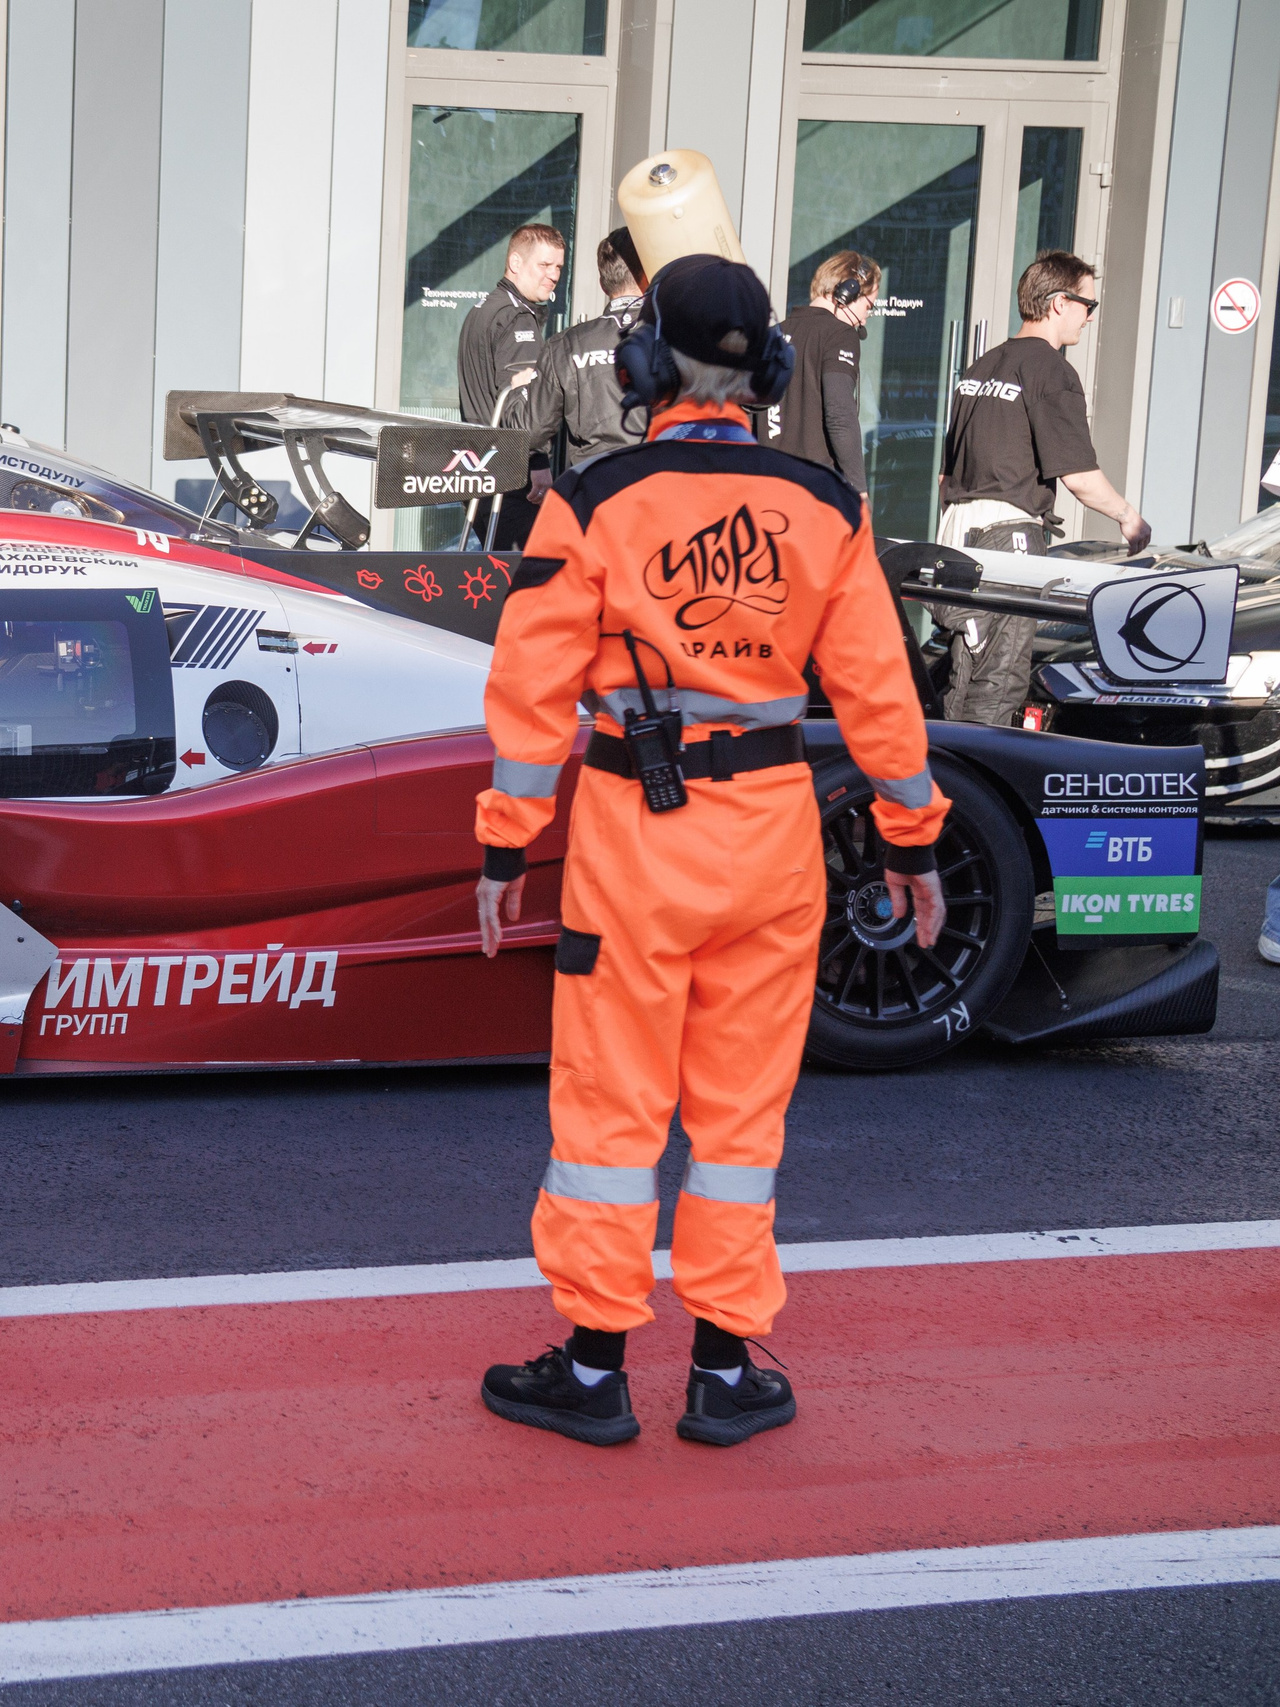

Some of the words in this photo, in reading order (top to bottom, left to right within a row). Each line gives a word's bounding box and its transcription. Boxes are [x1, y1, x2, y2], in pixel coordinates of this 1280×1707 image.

[403, 471, 496, 494] avexima
[1121, 696, 1207, 706] MARSHALL
[1043, 773, 1198, 796] СЕНСОТЕК
[1041, 806, 1089, 815] датчики
[1091, 804, 1100, 814] &
[1101, 806, 1147, 814] системы
[1148, 805, 1198, 815] контроля
[1107, 836, 1153, 862] ВТБ
[1061, 894, 1120, 913] IKON
[1127, 893, 1195, 912] TYRES
[44, 943, 339, 1009] ИМТРЕЙД
[39, 1013, 129, 1036] ГРУПП
